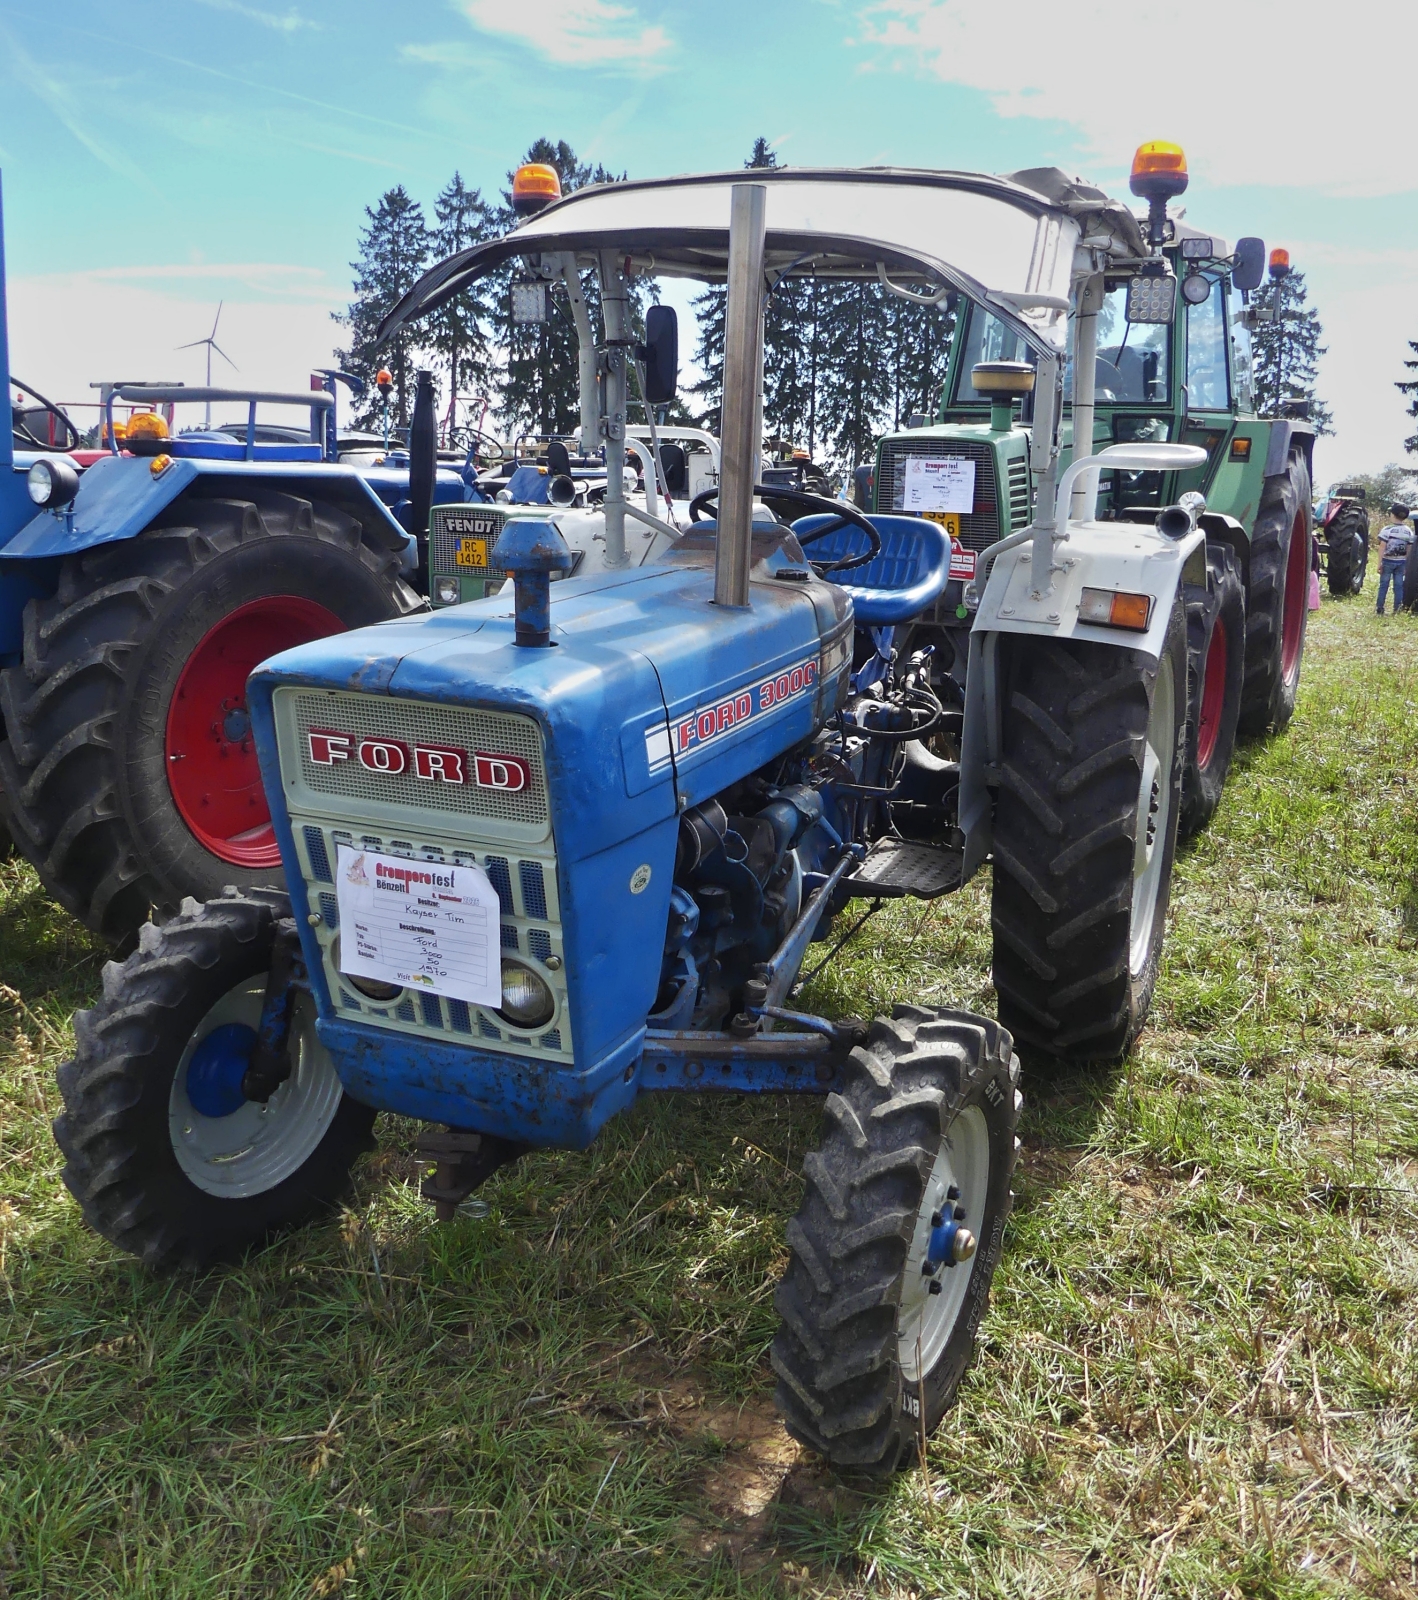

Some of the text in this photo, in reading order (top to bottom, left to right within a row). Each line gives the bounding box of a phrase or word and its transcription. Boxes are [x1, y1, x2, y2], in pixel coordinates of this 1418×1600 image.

[446, 518, 494, 533] FENDT
[464, 541, 477, 552] RC
[460, 553, 482, 565] 1412
[680, 693, 751, 752] FORD
[308, 728, 529, 792] FORD
[1173, 723, 1187, 790] BKT
[376, 879, 405, 893] Bënzelt
[405, 904, 464, 923] Kayser Tim
[413, 936, 438, 948] Ford
[420, 947, 443, 959] 3000
[427, 957, 440, 965] 50
[397, 972, 411, 981] Visit
[418, 964, 447, 976] 1970
[984, 1079, 1005, 1107] BKT
